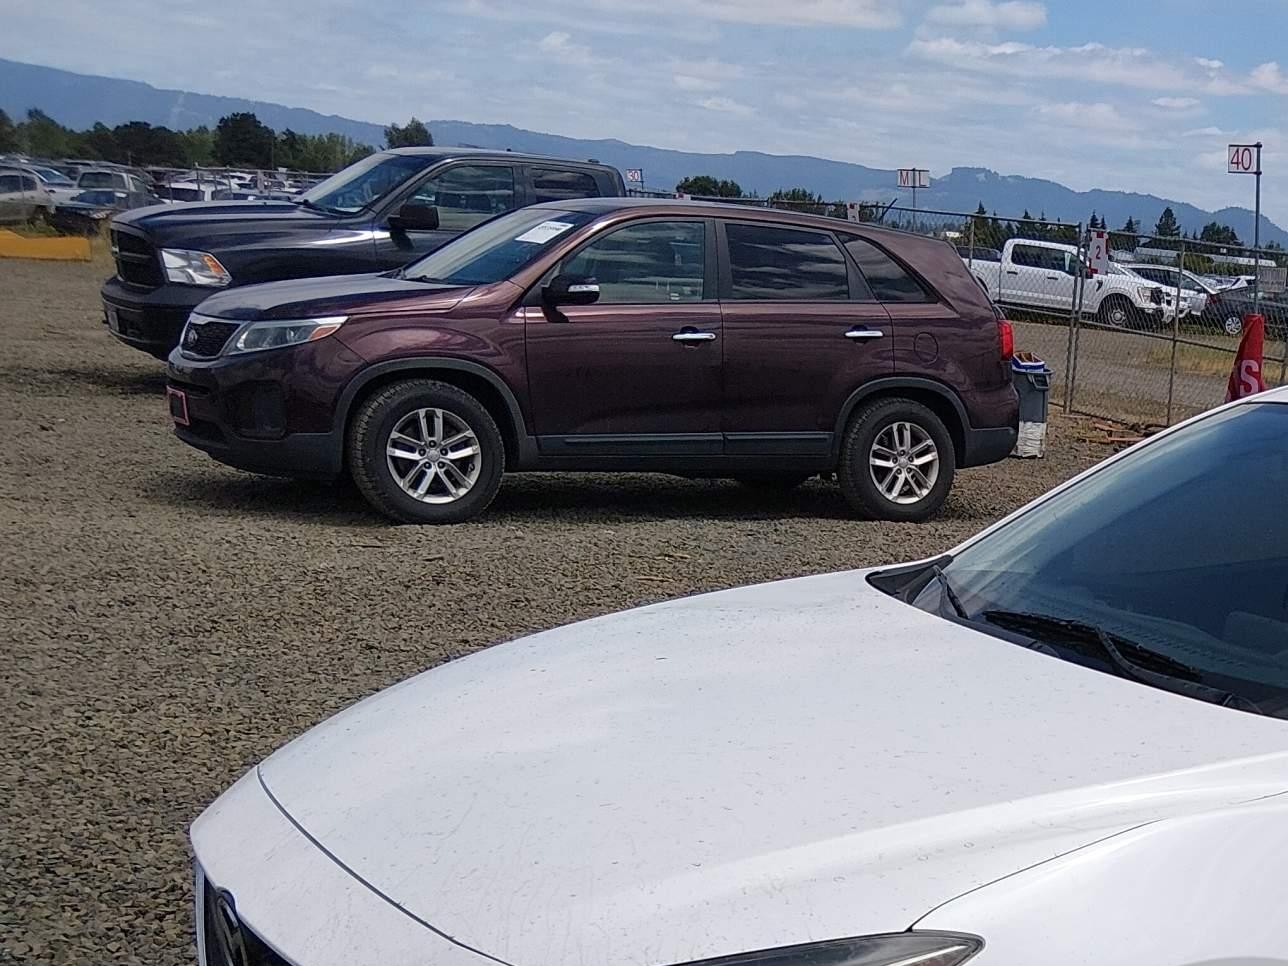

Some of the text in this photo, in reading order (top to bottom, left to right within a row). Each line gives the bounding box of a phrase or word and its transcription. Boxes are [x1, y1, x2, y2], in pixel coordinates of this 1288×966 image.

[1230, 147, 1252, 171] 40
[628, 170, 640, 181] 30
[900, 170, 909, 186] M
[1095, 244, 1102, 260] 2
[1239, 359, 1260, 397] S
